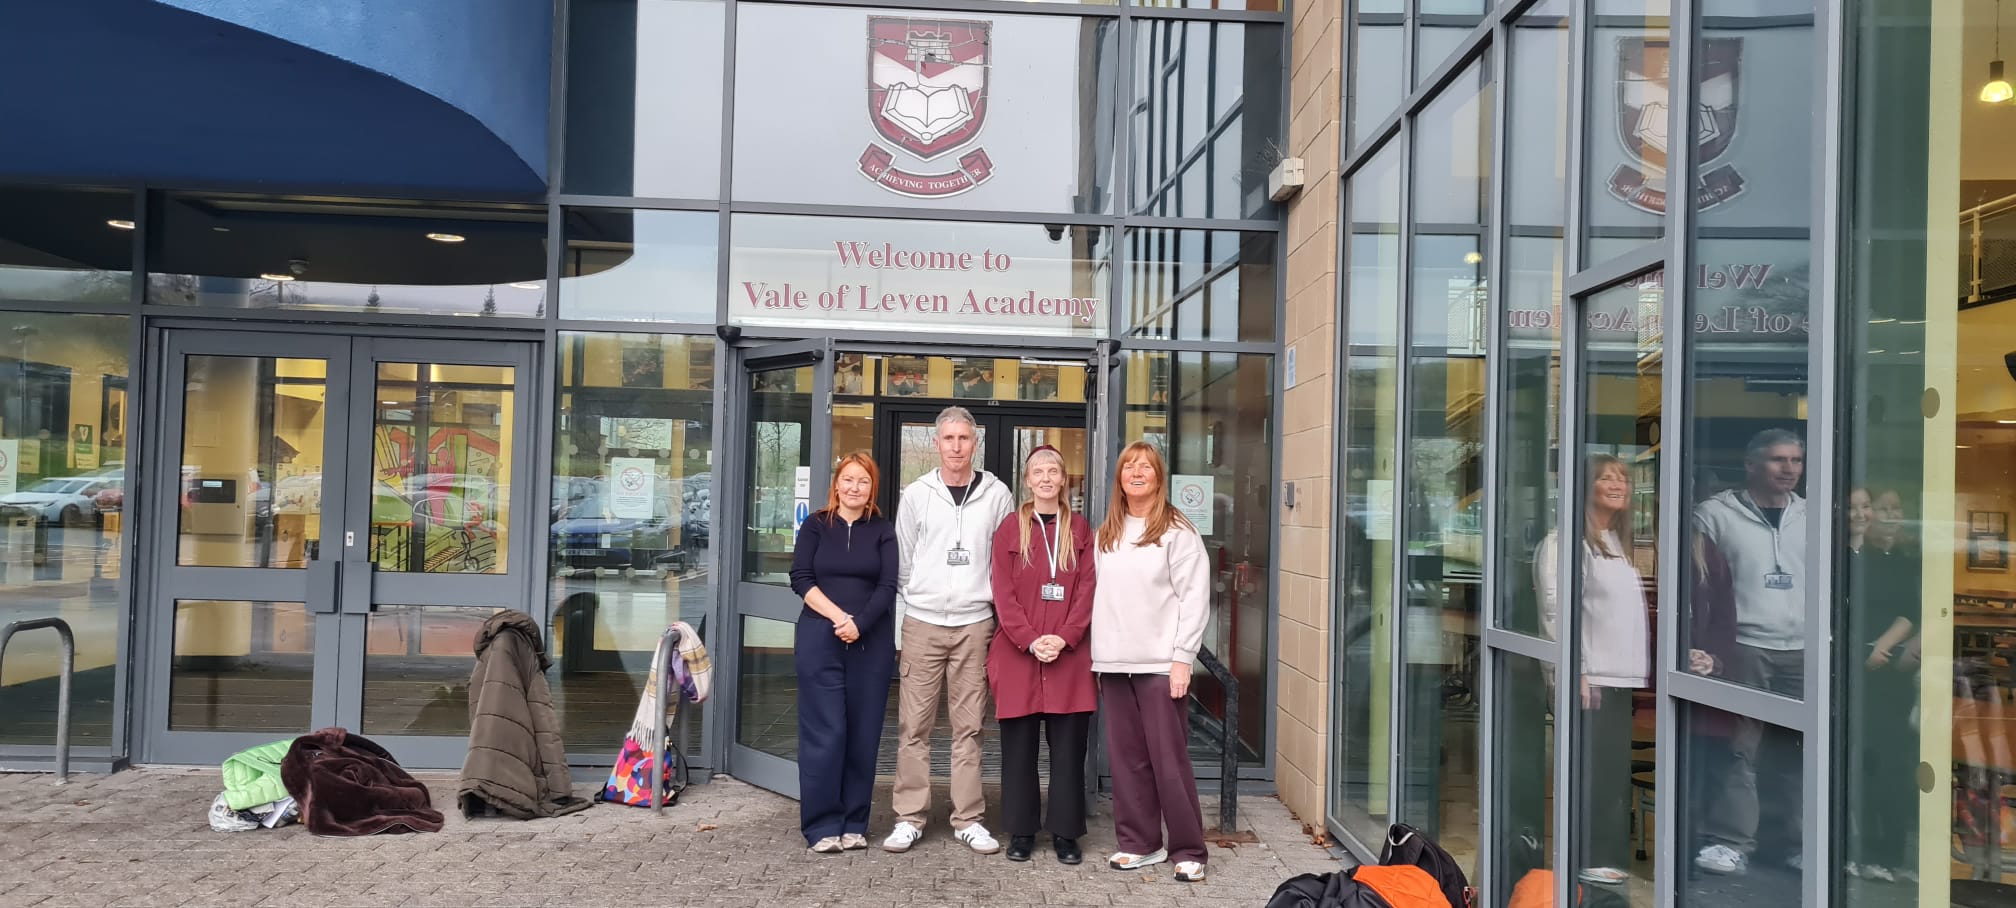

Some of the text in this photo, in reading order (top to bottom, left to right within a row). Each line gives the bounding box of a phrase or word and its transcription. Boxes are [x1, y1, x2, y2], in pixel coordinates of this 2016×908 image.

[870, 164, 982, 190] ACHIEVING TOGETHER
[834, 240, 1011, 272] Welcome to
[742, 281, 1100, 323] Vale of Leven Academy
